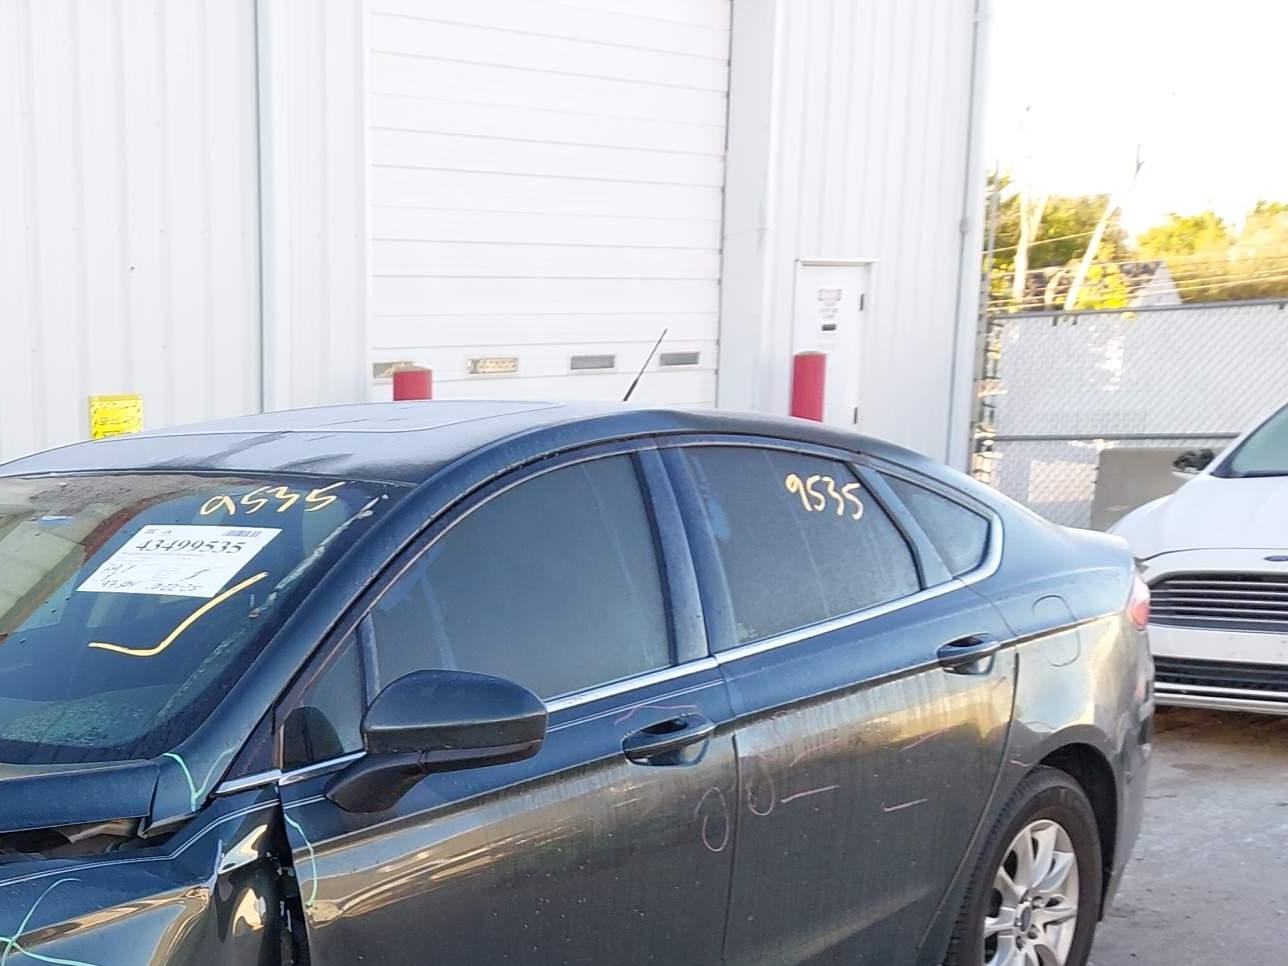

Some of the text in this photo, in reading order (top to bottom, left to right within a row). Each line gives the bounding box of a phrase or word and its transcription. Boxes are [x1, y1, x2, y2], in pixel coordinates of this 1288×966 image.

[200, 481, 346, 515] 9535
[786, 473, 863, 520] 9535
[136, 538, 248, 554] 43499535
